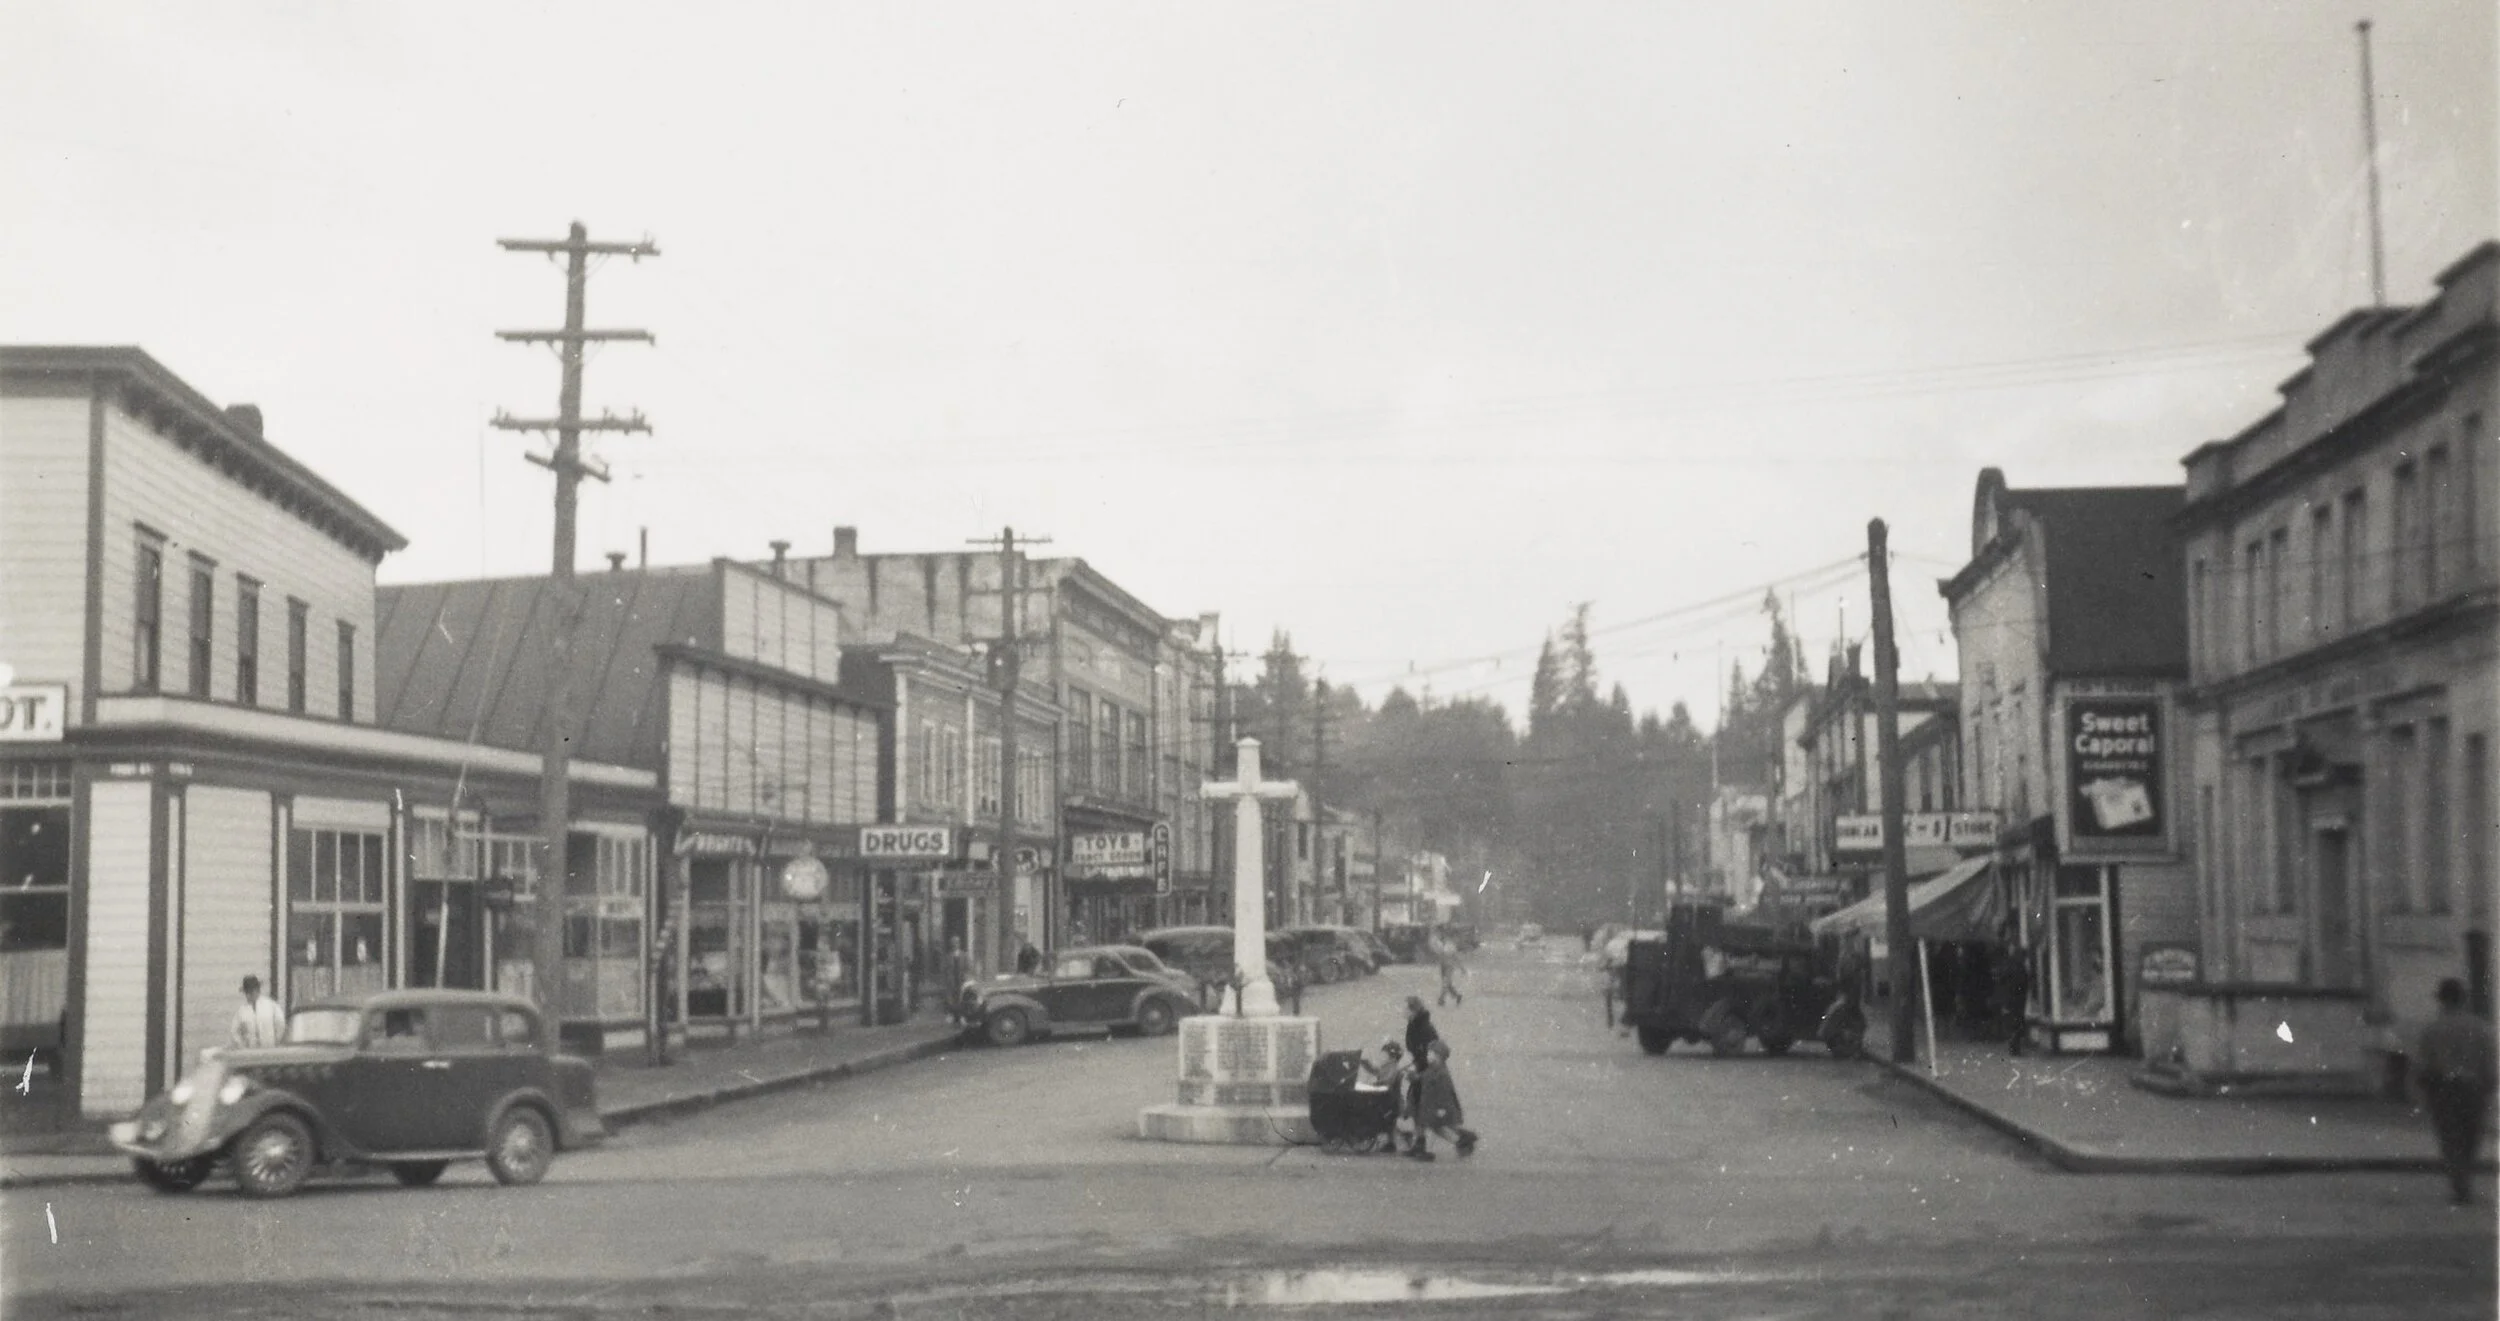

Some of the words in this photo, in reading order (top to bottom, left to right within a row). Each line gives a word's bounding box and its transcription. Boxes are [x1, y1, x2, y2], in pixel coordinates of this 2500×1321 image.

[2081, 712, 2149, 733] Sweet
[2075, 734, 2155, 758] Caporal
[866, 832, 944, 852] DRUGS
[1084, 834, 1131, 851] TOYS
